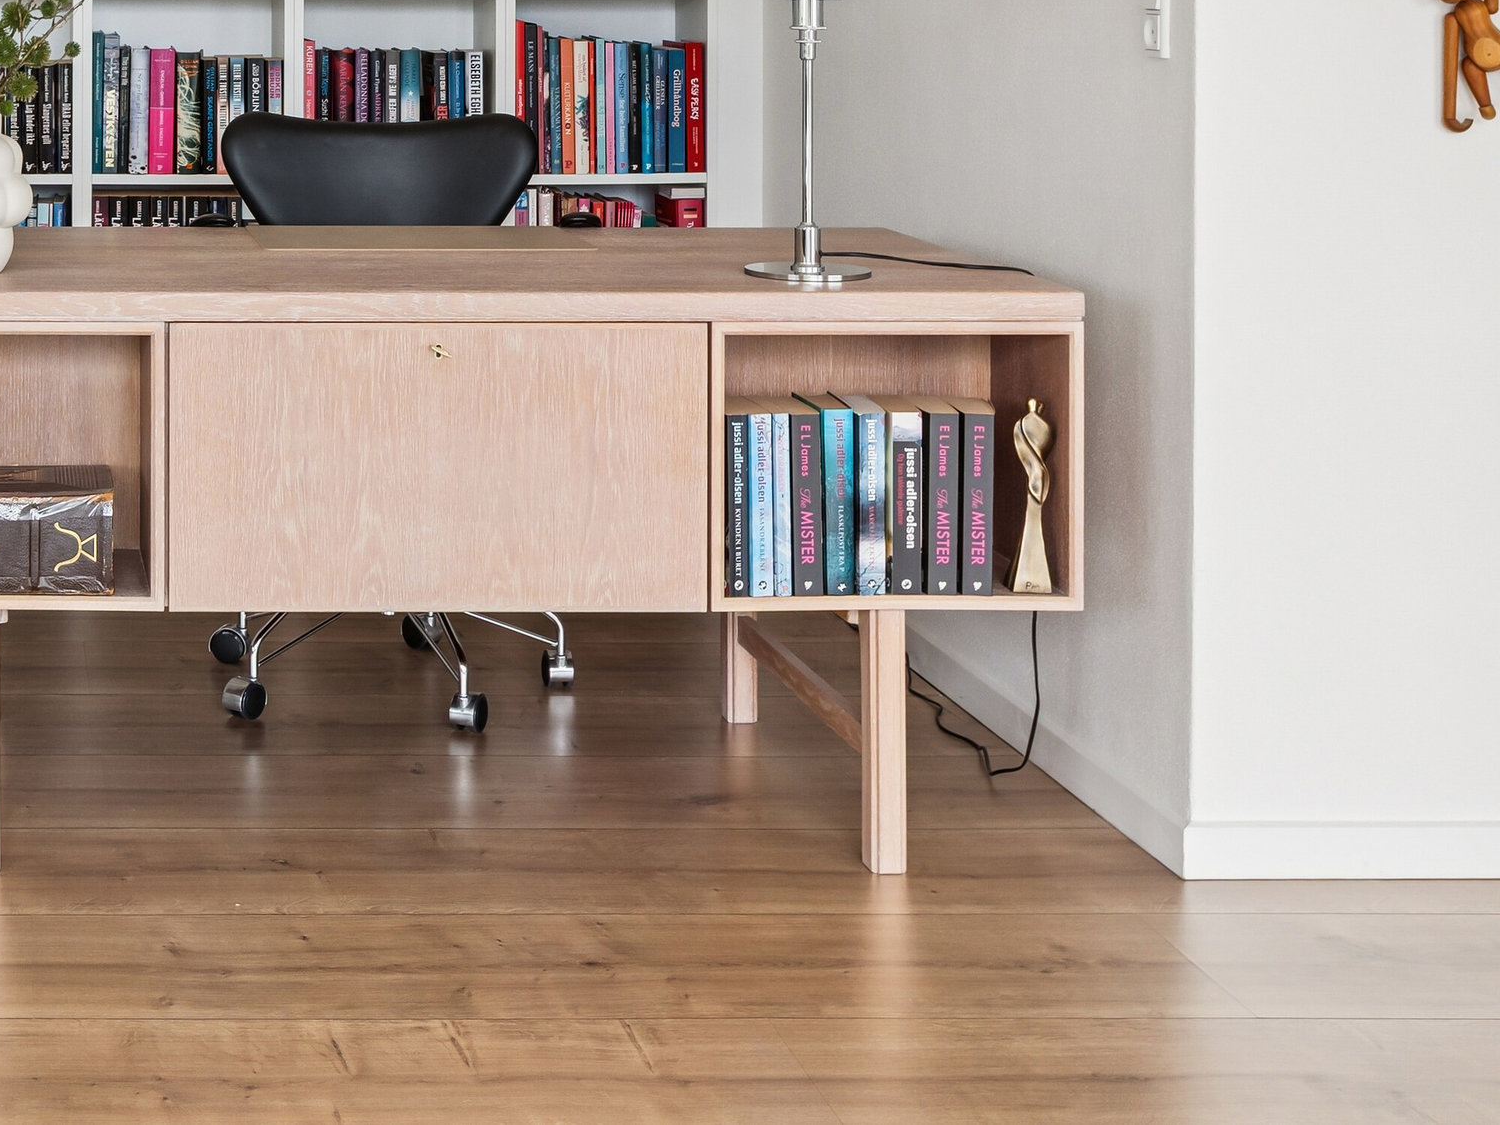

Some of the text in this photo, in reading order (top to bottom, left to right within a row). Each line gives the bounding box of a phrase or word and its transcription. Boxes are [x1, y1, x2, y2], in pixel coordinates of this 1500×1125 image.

[305, 45, 314, 75] KUREN
[470, 54, 482, 95] ELSEBETH
[527, 53, 536, 73] MANS
[671, 68, 681, 128] Grillhåndbog
[105, 88, 118, 168] VESTKYSTEN
[731, 421, 744, 446] jussi
[833, 418, 846, 443] jussi
[733, 446, 744, 504] adler-olsen
[866, 418, 879, 502] jussi adler-olsen
[799, 425, 815, 565] E L James The MISTER
[903, 447, 918, 550] jussi adler-olsen
[935, 425, 951, 565] E L James The MISTER
[969, 425, 986, 566] E L James The MISTER
[734, 508, 743, 545] KVINDEN
[837, 504, 846, 550] FLASKEPOST
[734, 551, 743, 578] BURET
[837, 551, 846, 566] FRA
